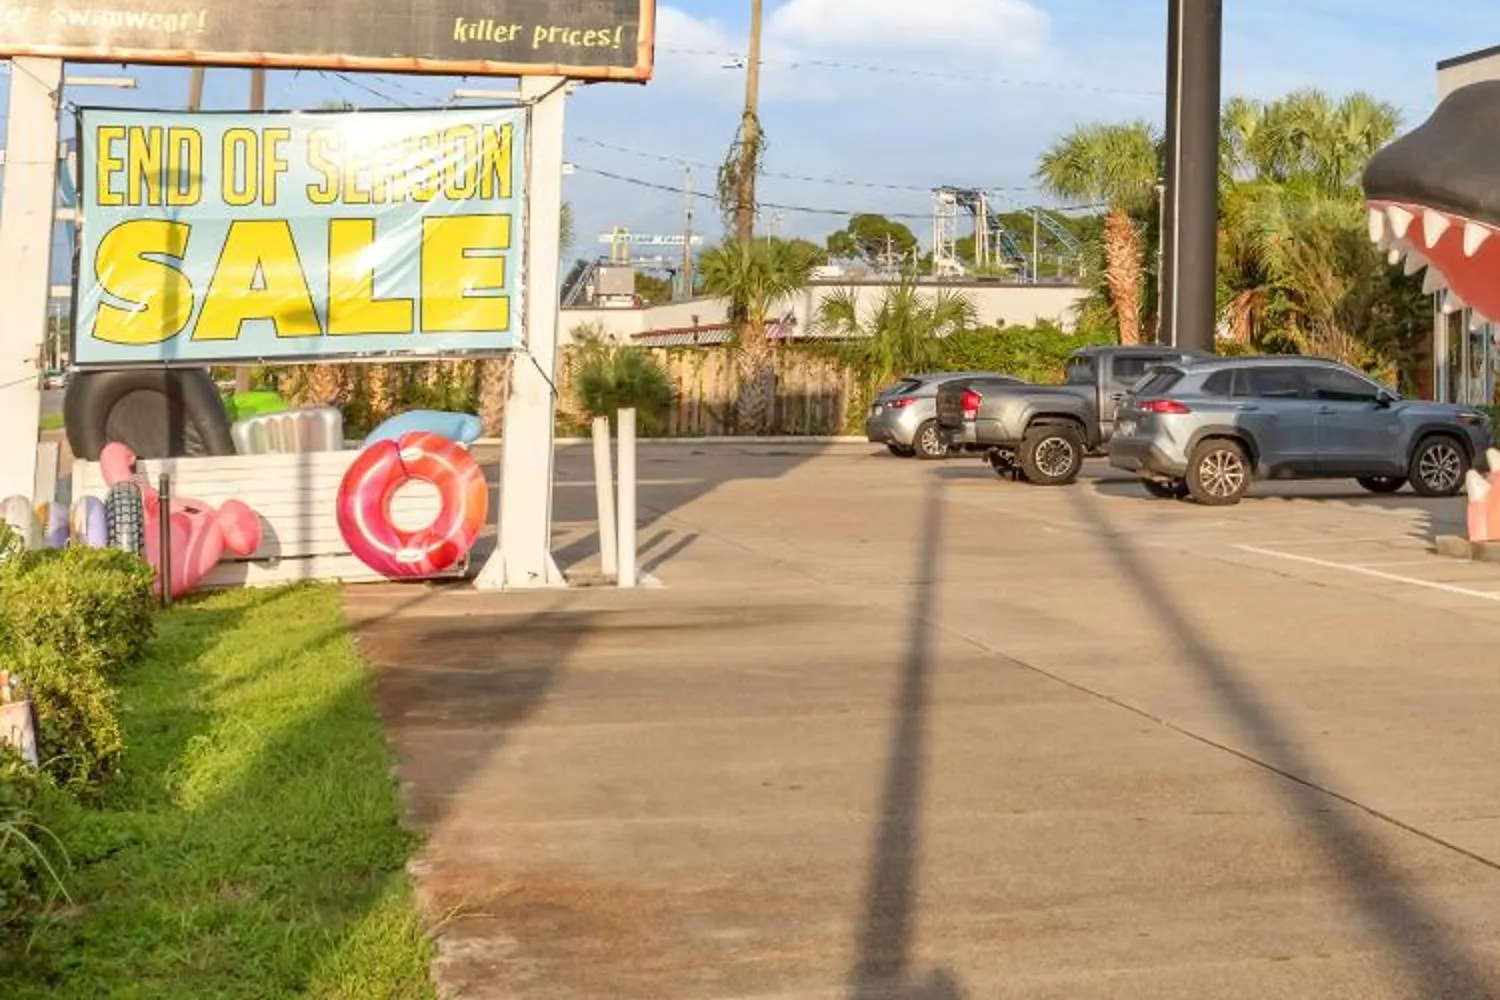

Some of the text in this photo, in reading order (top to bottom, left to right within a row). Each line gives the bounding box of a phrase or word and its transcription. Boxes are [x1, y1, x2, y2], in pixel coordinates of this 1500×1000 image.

[453, 17, 623, 50] killer prices!
[97, 125, 201, 206] END
[221, 126, 291, 206] OF
[92, 213, 513, 344] SALE
